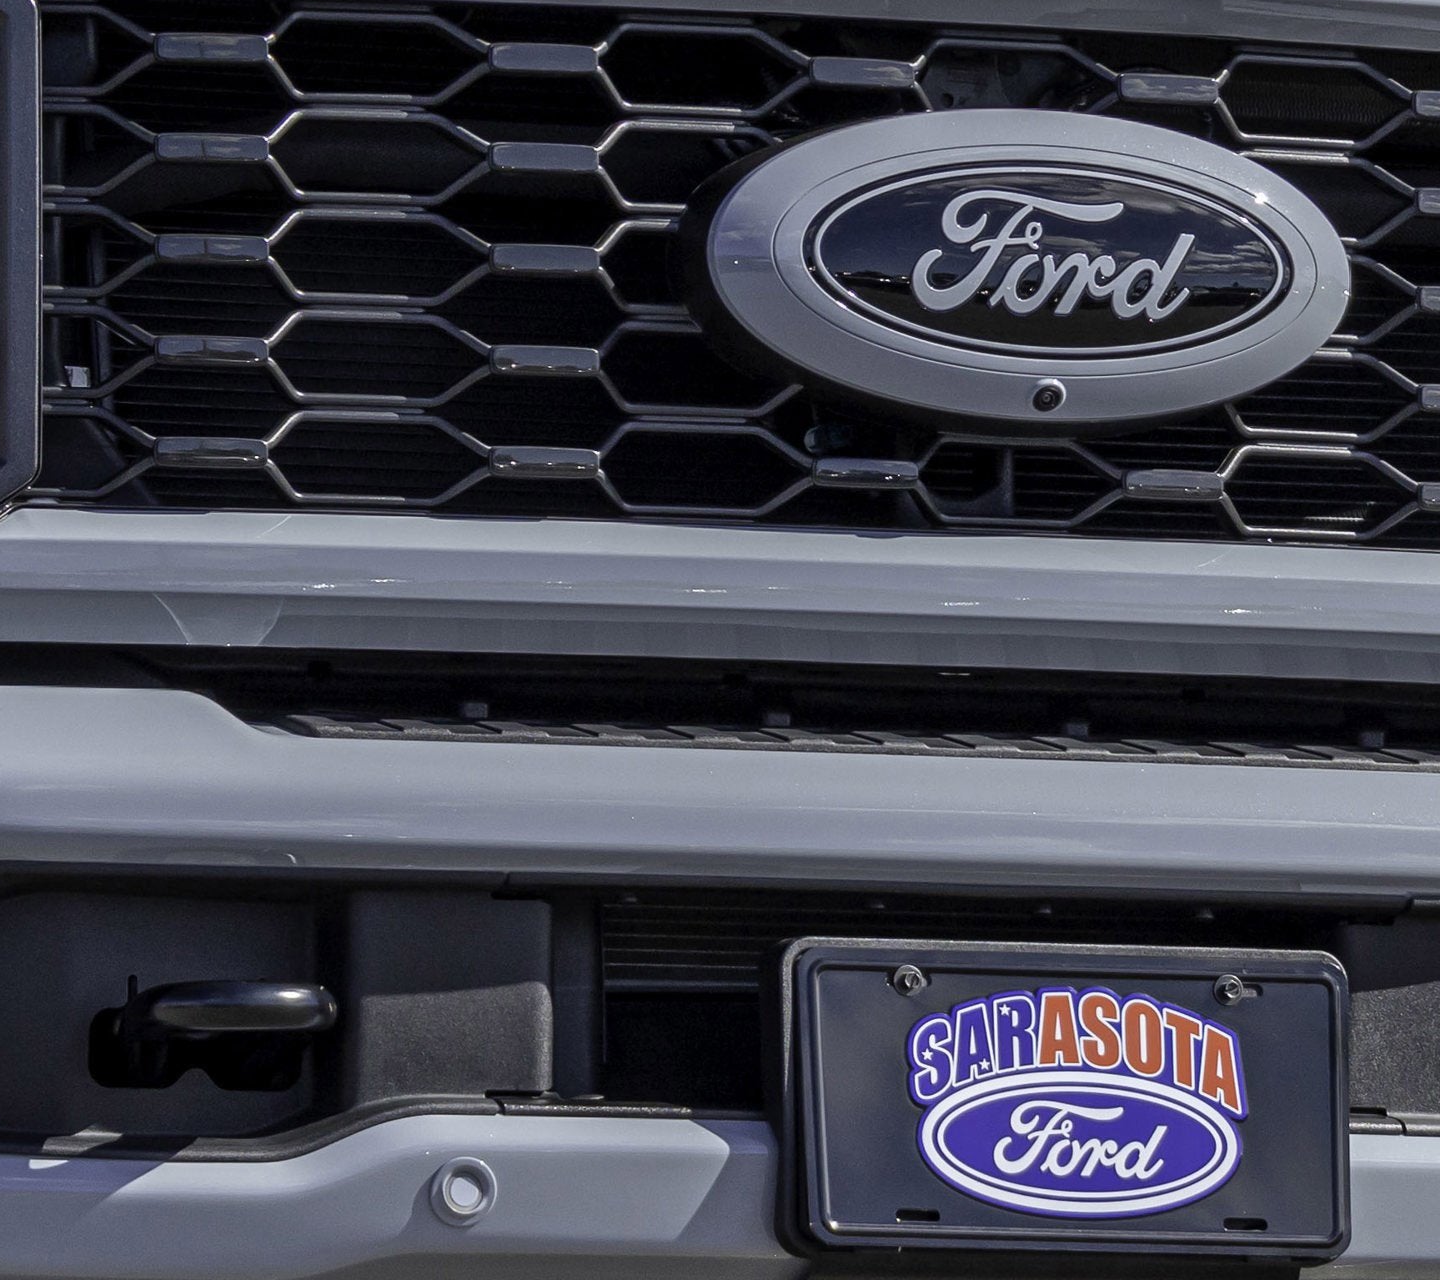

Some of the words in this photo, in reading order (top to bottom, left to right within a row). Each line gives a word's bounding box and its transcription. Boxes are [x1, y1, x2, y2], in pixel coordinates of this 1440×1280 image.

[910, 188, 1196, 322] Ford
[909, 986, 1248, 1120] SARASOTA
[993, 1099, 1166, 1181] Ford
